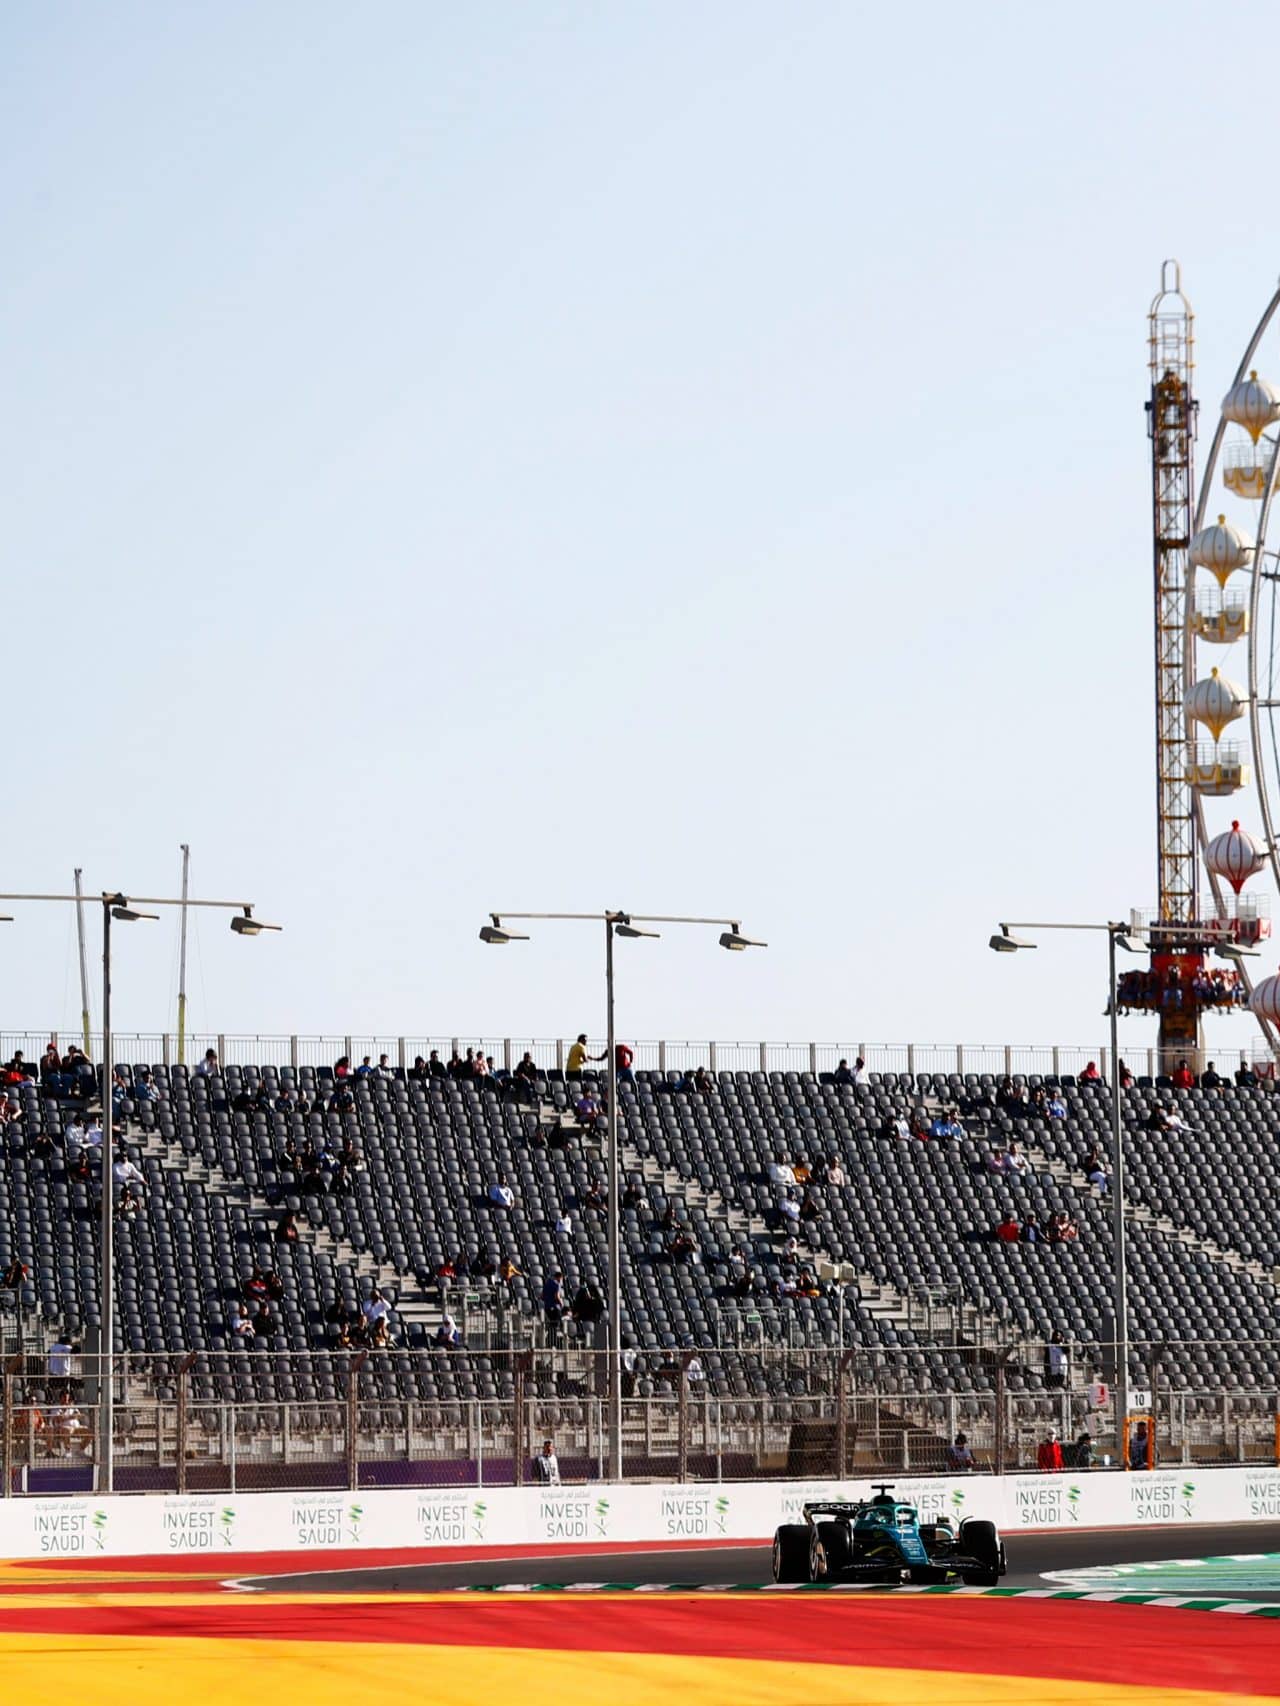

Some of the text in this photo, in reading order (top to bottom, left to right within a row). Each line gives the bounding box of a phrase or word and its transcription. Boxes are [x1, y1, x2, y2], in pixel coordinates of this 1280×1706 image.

[1134, 1394, 1145, 1406] 10
[1015, 1489, 1063, 1505] INVEST
[1131, 1486, 1177, 1501] INVEST
[417, 1505, 468, 1522] INVEST
[540, 1503, 590, 1519] INVEST
[661, 1500, 710, 1516] INVEST
[1021, 1507, 1061, 1523] SAUDI
[1136, 1503, 1175, 1519] SAUDI
[34, 1514, 87, 1532] INVEST
[163, 1511, 215, 1528] INVEST
[292, 1508, 344, 1525] INVEST
[424, 1525, 466, 1541] SAUDI
[546, 1521, 588, 1537] SAUDI
[667, 1518, 708, 1534] SAUDI
[40, 1534, 85, 1551] SAUDI
[169, 1530, 213, 1548] SAUDI
[298, 1527, 341, 1544] SAUDI
